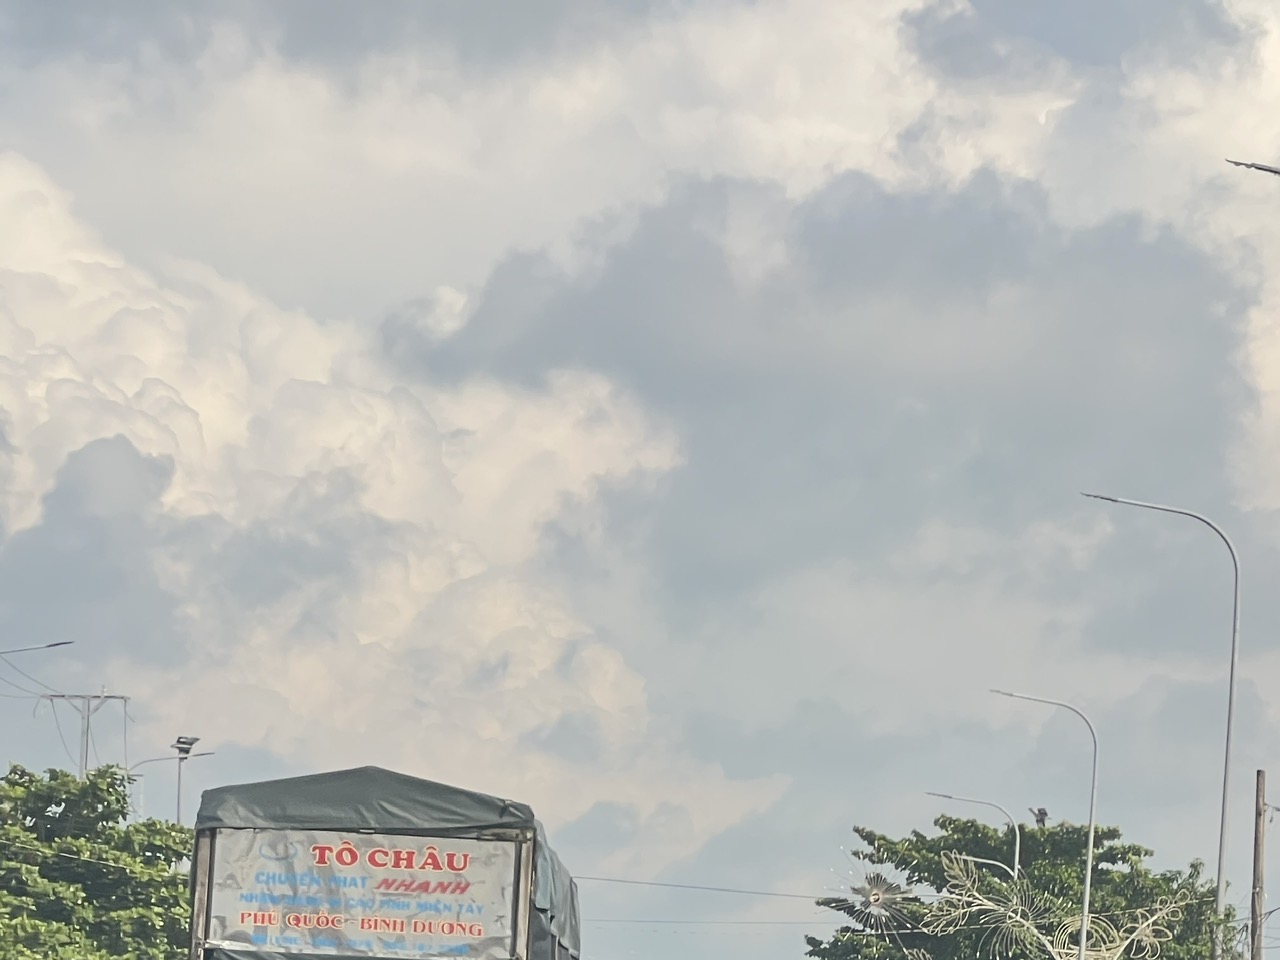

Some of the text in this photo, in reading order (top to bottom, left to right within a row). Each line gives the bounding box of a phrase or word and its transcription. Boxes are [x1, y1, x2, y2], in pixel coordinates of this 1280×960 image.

[311, 840, 470, 872] TÔ CHÂU
[374, 878, 471, 895] NHANH
[240, 909, 280, 926] PHÚ
[286, 908, 344, 930] QUỐC
[359, 914, 406, 933] BÌNH
